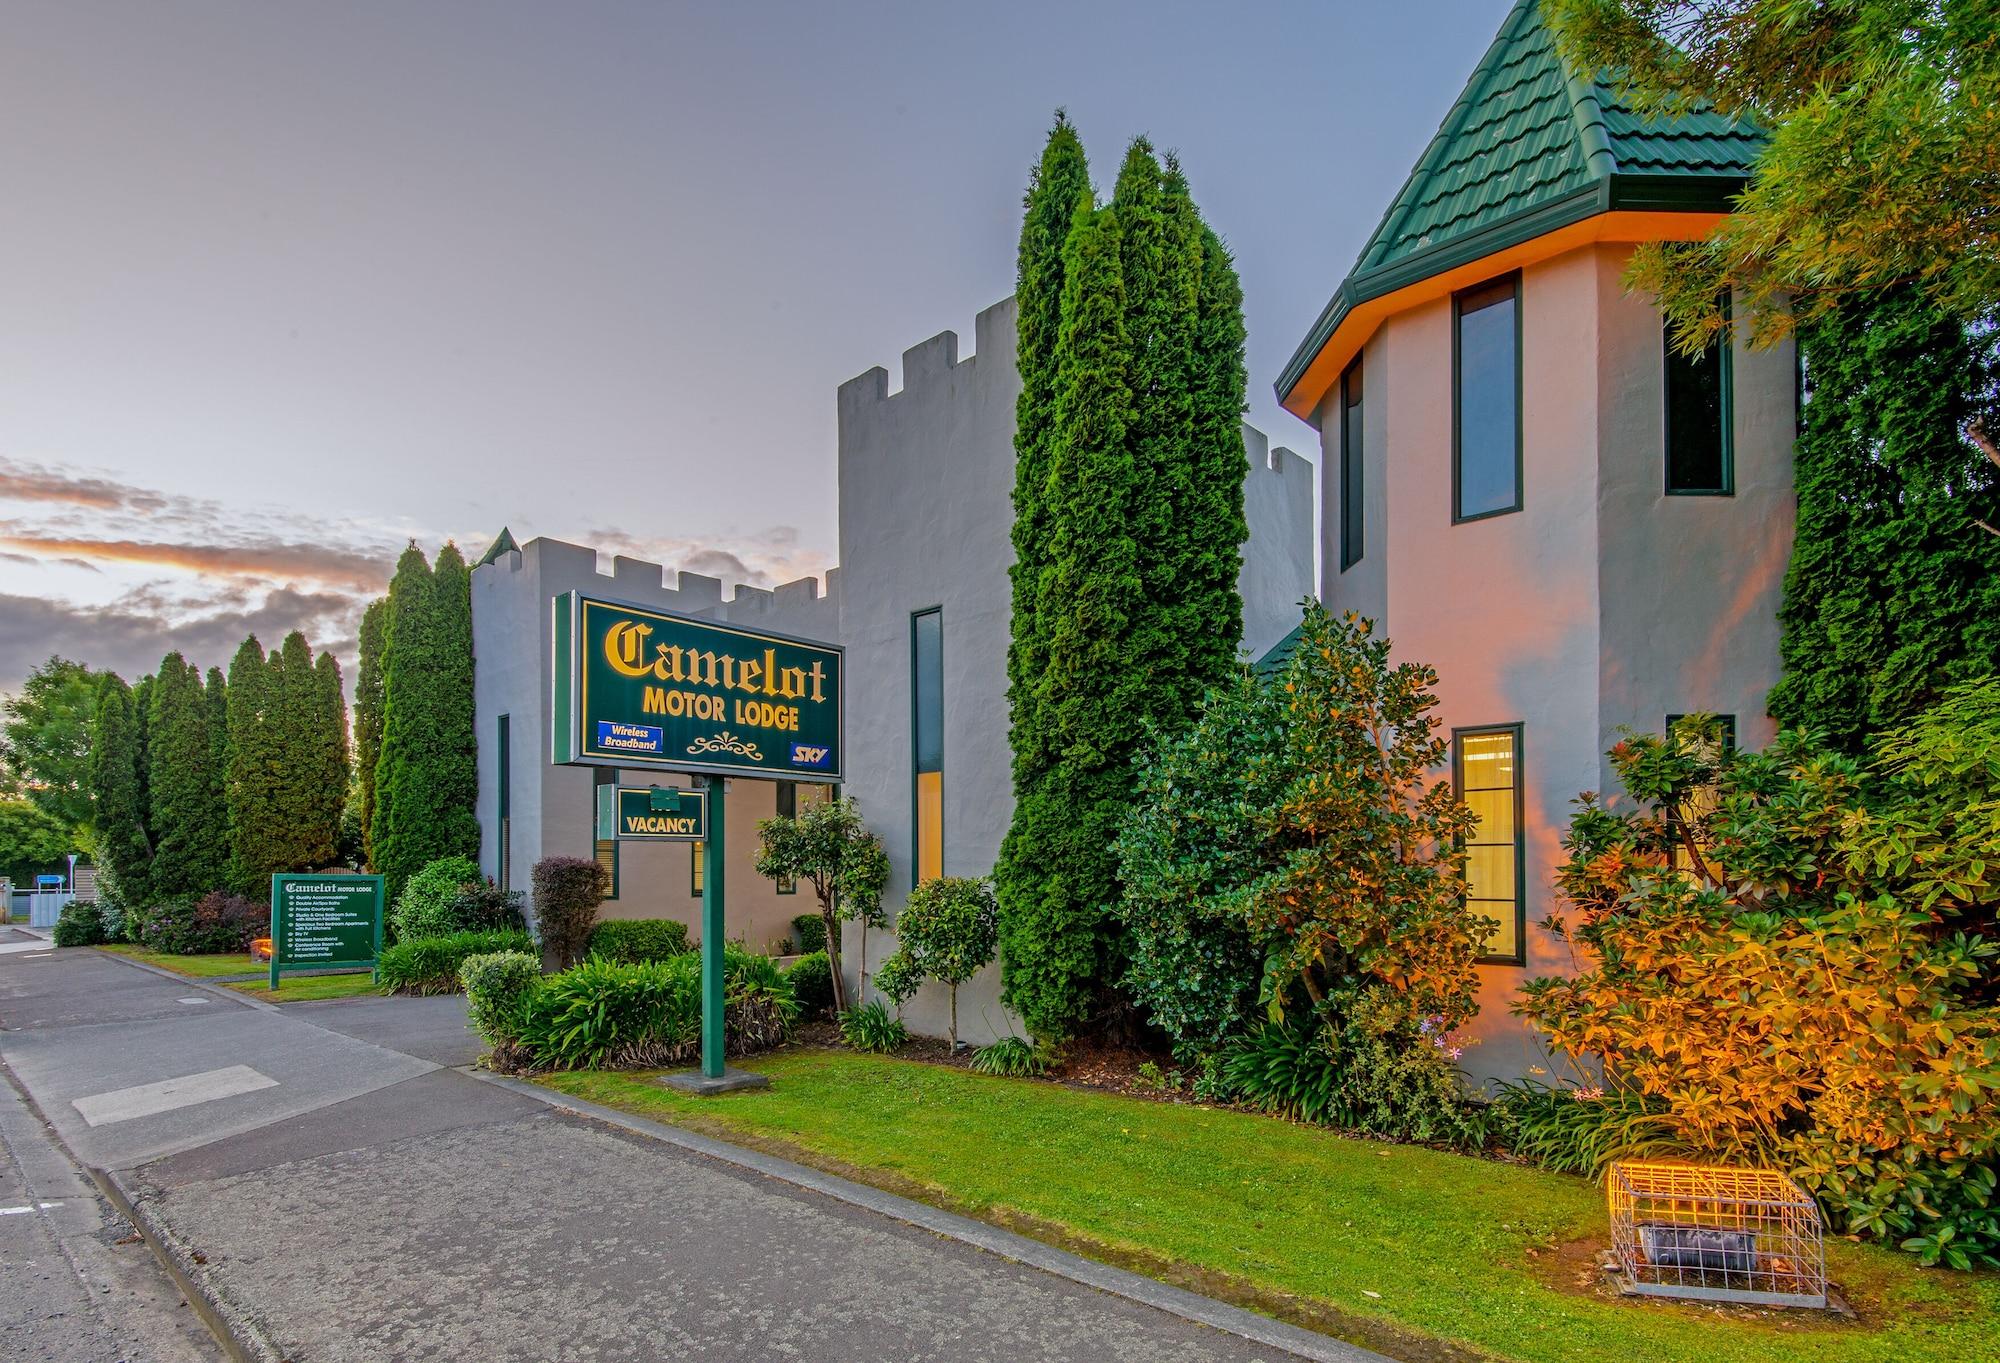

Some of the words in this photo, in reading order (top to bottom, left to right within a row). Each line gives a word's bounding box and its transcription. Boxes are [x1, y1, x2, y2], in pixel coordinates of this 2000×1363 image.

[604, 620, 827, 704] Camelot
[643, 686, 726, 722] MOTOR
[735, 699, 799, 731] LODGE
[611, 725, 649, 738] Wireless
[604, 736, 657, 751] Broadband
[792, 746, 829, 764] SKY
[626, 816, 696, 833] VACANCY
[285, 883, 337, 893] Camelot
